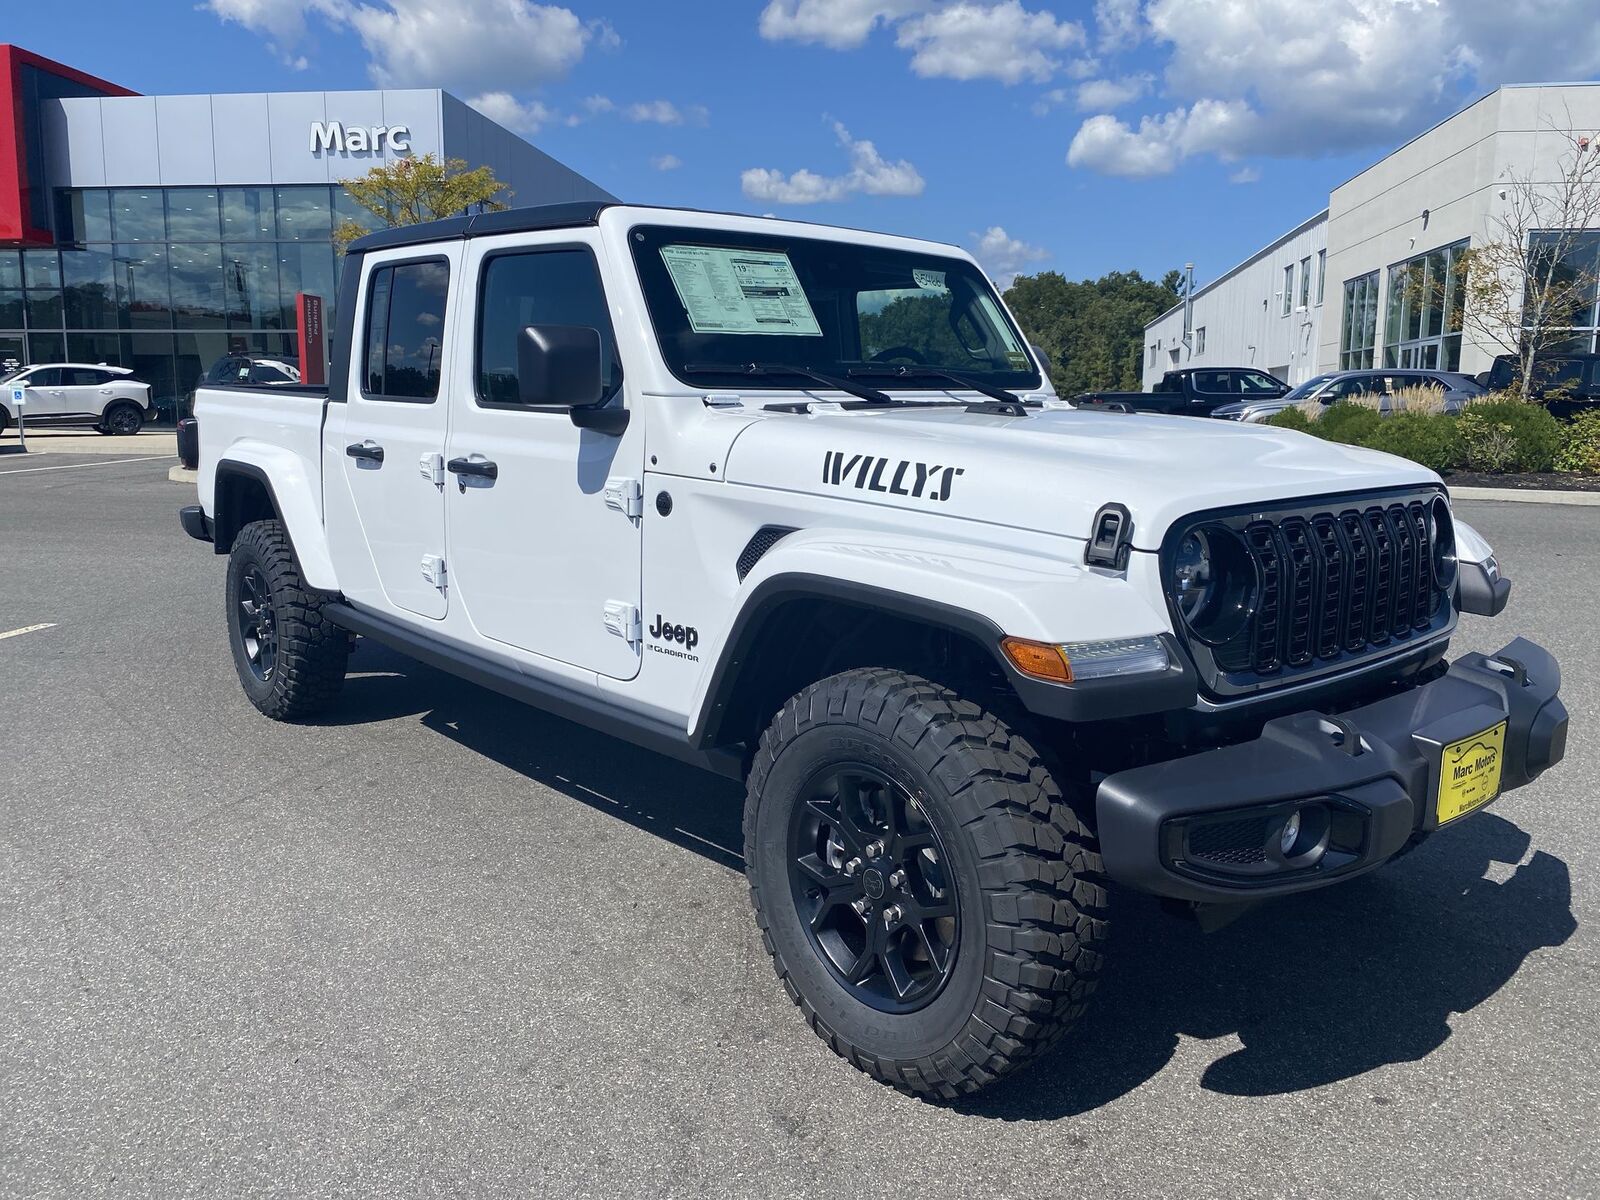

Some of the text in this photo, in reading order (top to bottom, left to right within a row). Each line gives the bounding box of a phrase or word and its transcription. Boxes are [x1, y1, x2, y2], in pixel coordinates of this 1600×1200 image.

[309, 121, 408, 152] Marc
[737, 265, 747, 273] 19
[822, 451, 965, 501] WILLYS
[649, 614, 698, 651] Jeep
[653, 645, 699, 663] GLADIATOR
[1453, 764, 1473, 781] Marc
[1475, 752, 1496, 772] Motors
